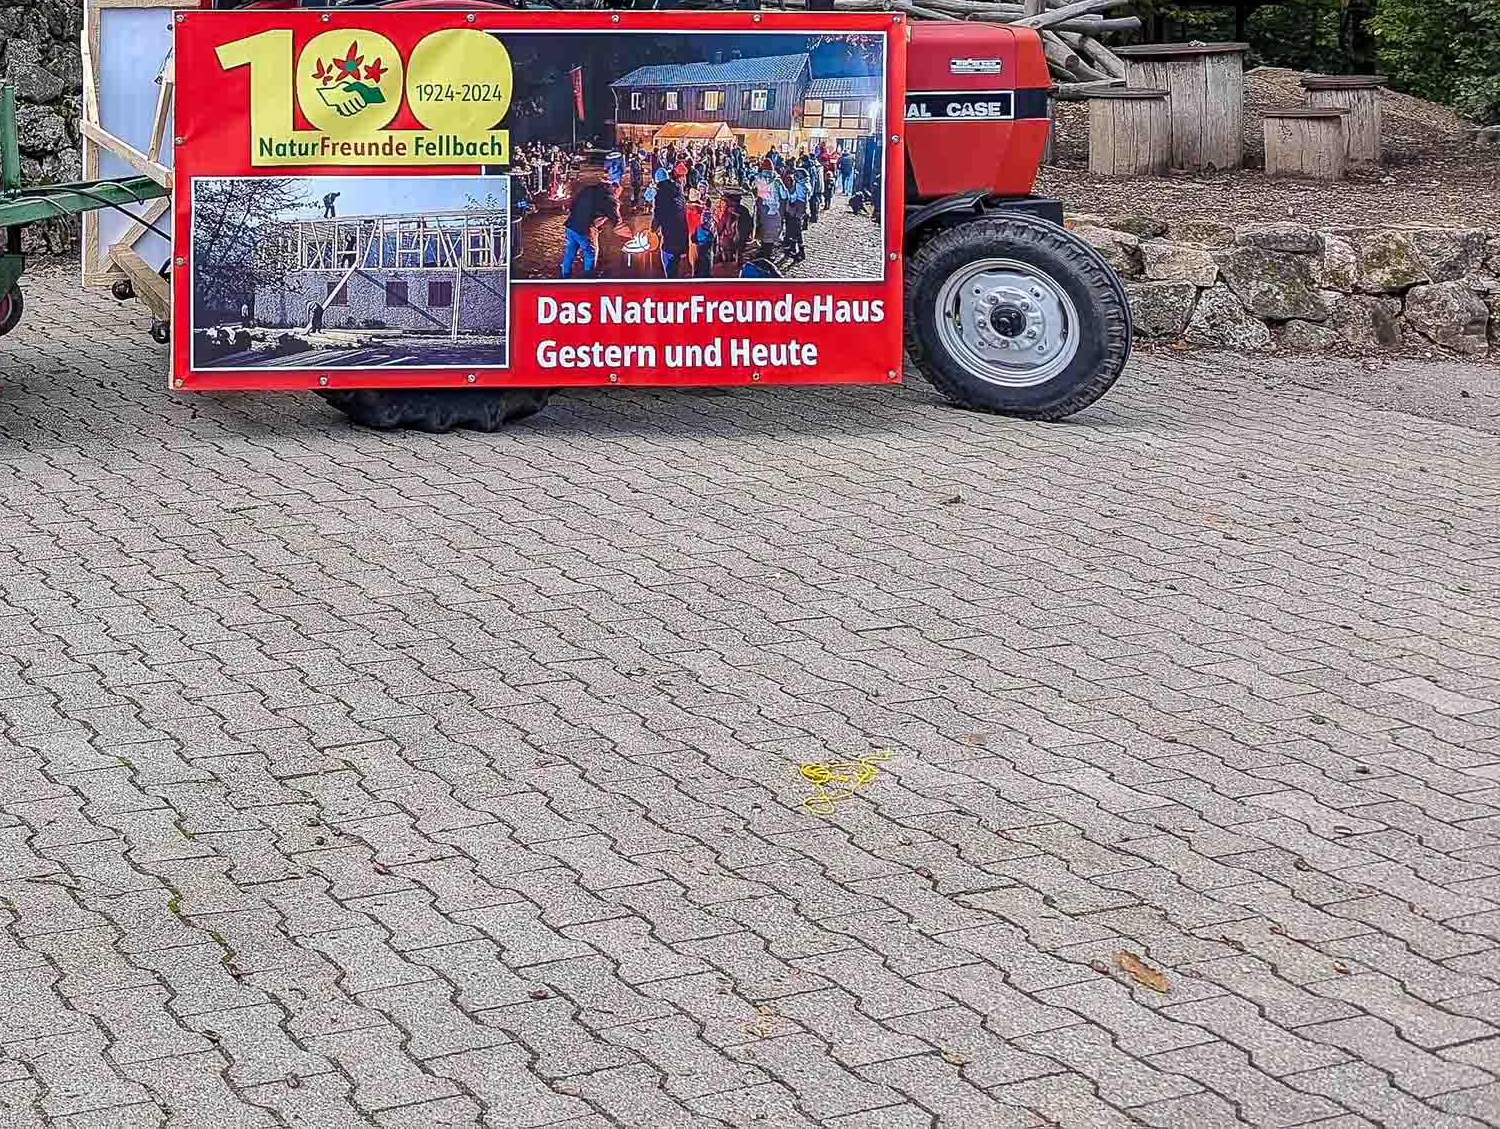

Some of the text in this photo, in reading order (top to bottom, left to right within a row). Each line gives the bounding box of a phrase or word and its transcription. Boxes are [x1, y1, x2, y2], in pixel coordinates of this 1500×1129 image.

[214, 28, 513, 132] 100
[416, 83, 503, 103] 1924-2024
[946, 101, 1001, 117] CASE
[258, 134, 503, 157] NaturFreunde Fellbach
[536, 292, 885, 325] Das NaturFreundeHaus
[535, 337, 819, 368] Gestern und Heute
